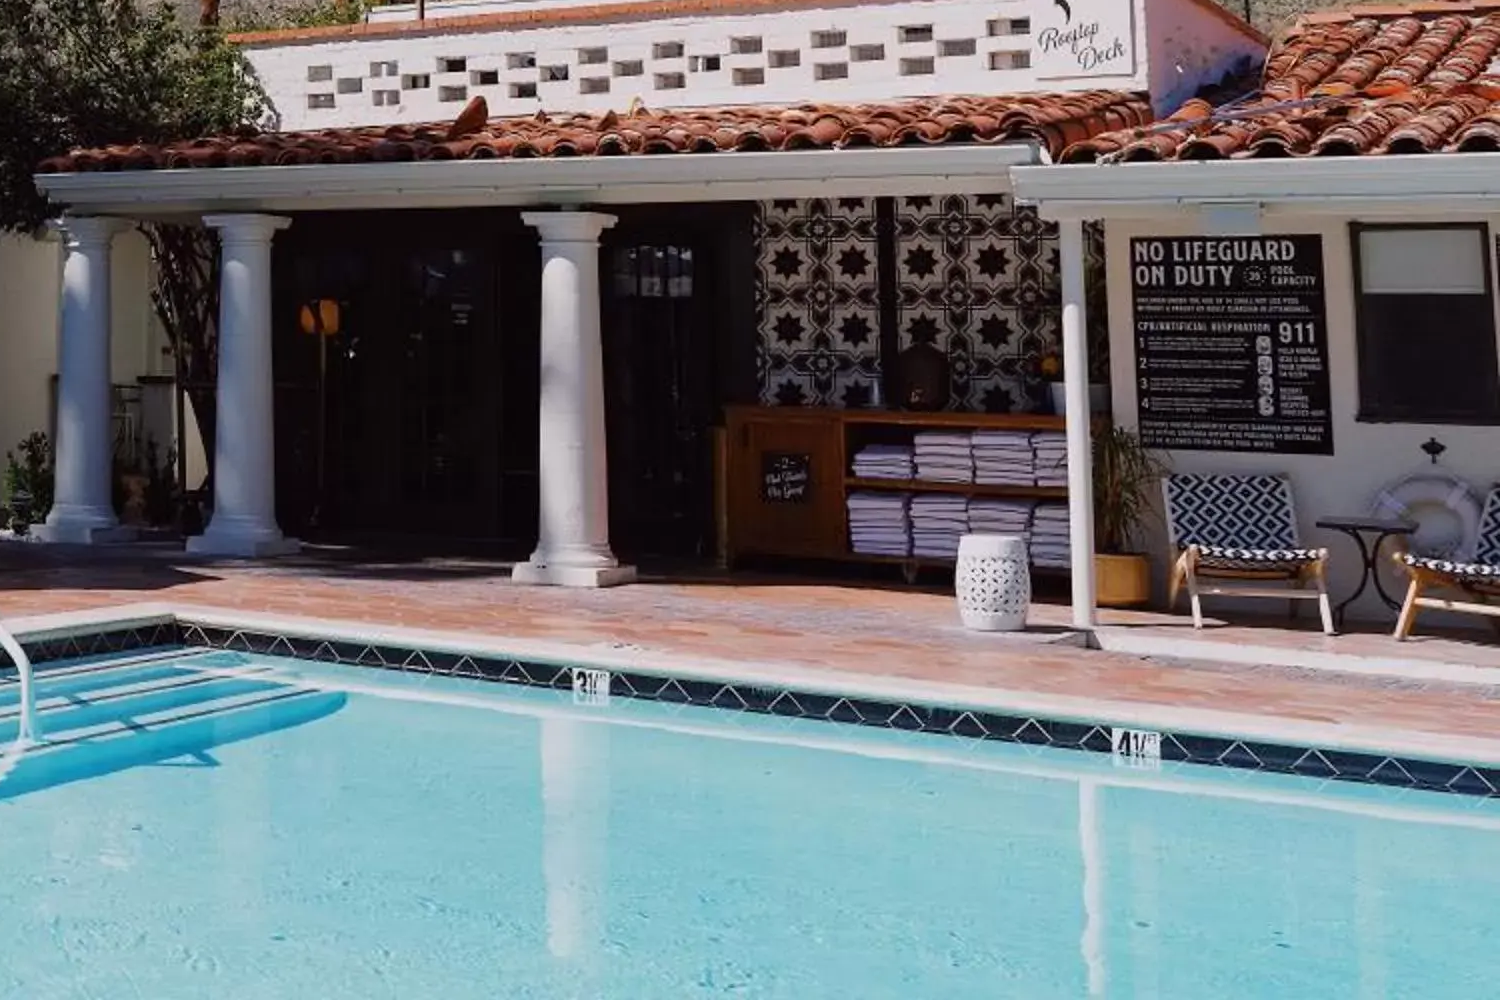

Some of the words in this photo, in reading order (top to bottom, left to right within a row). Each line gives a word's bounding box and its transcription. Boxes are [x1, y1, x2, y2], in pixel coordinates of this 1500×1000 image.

[1038, 22, 1099, 54] Rooftop
[1077, 37, 1126, 71] Deck
[1135, 241, 1164, 262] NO
[1172, 240, 1295, 262] LIFEGUARD
[1135, 265, 1165, 287] ON
[1174, 265, 1234, 287] DUTY
[1269, 265, 1294, 275] POOL
[1271, 275, 1316, 286] CAPACITY
[1279, 321, 1315, 344] 911
[1139, 357, 1148, 369] 2
[1140, 378, 1149, 390] 3
[1141, 398, 1150, 409] 4
